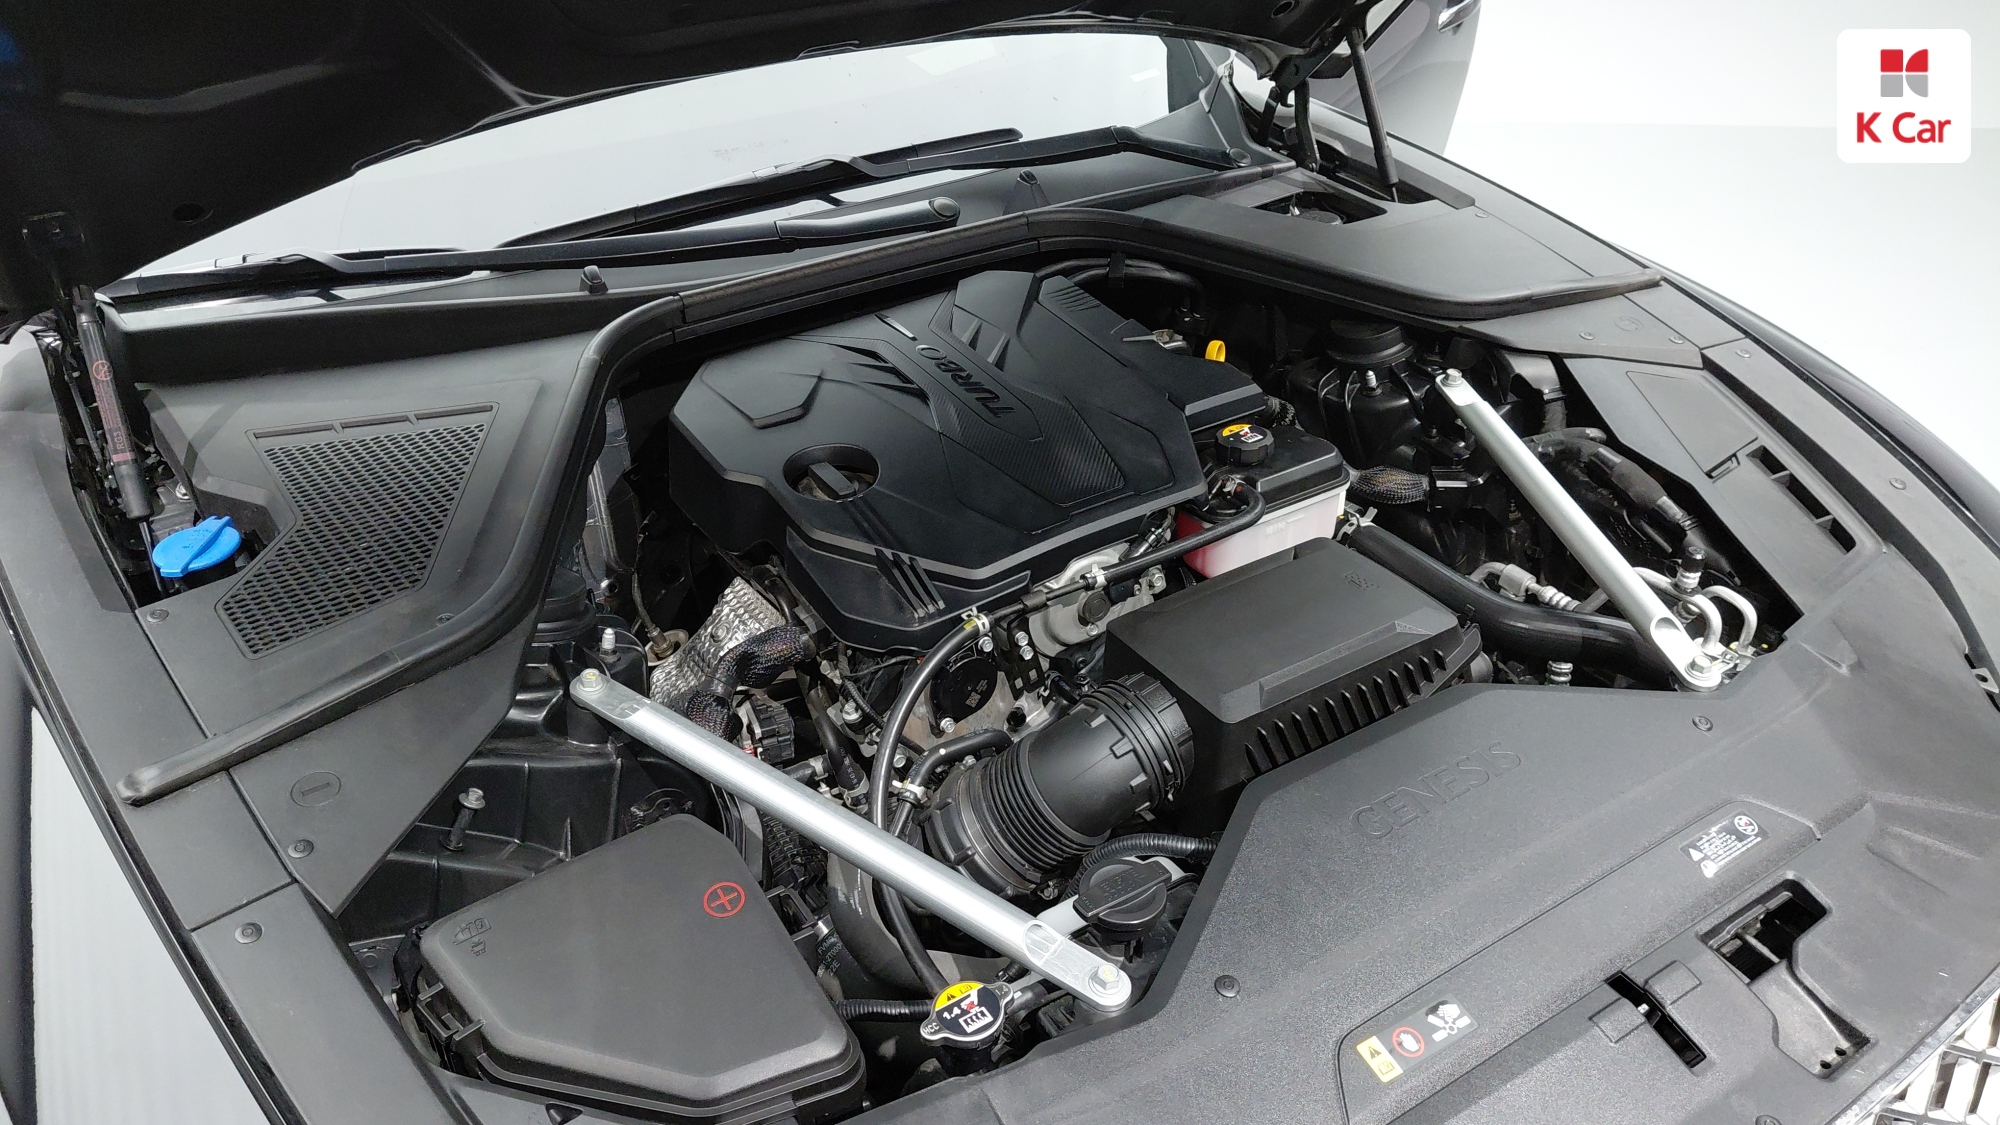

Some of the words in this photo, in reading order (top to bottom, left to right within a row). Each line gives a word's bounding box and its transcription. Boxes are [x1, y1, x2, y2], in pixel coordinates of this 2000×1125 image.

[916, 344, 1017, 418] TURBO
[1349, 741, 1522, 839] GENESIS
[922, 1022, 940, 1035] HCC
[942, 1006, 961, 1020] 1.4
